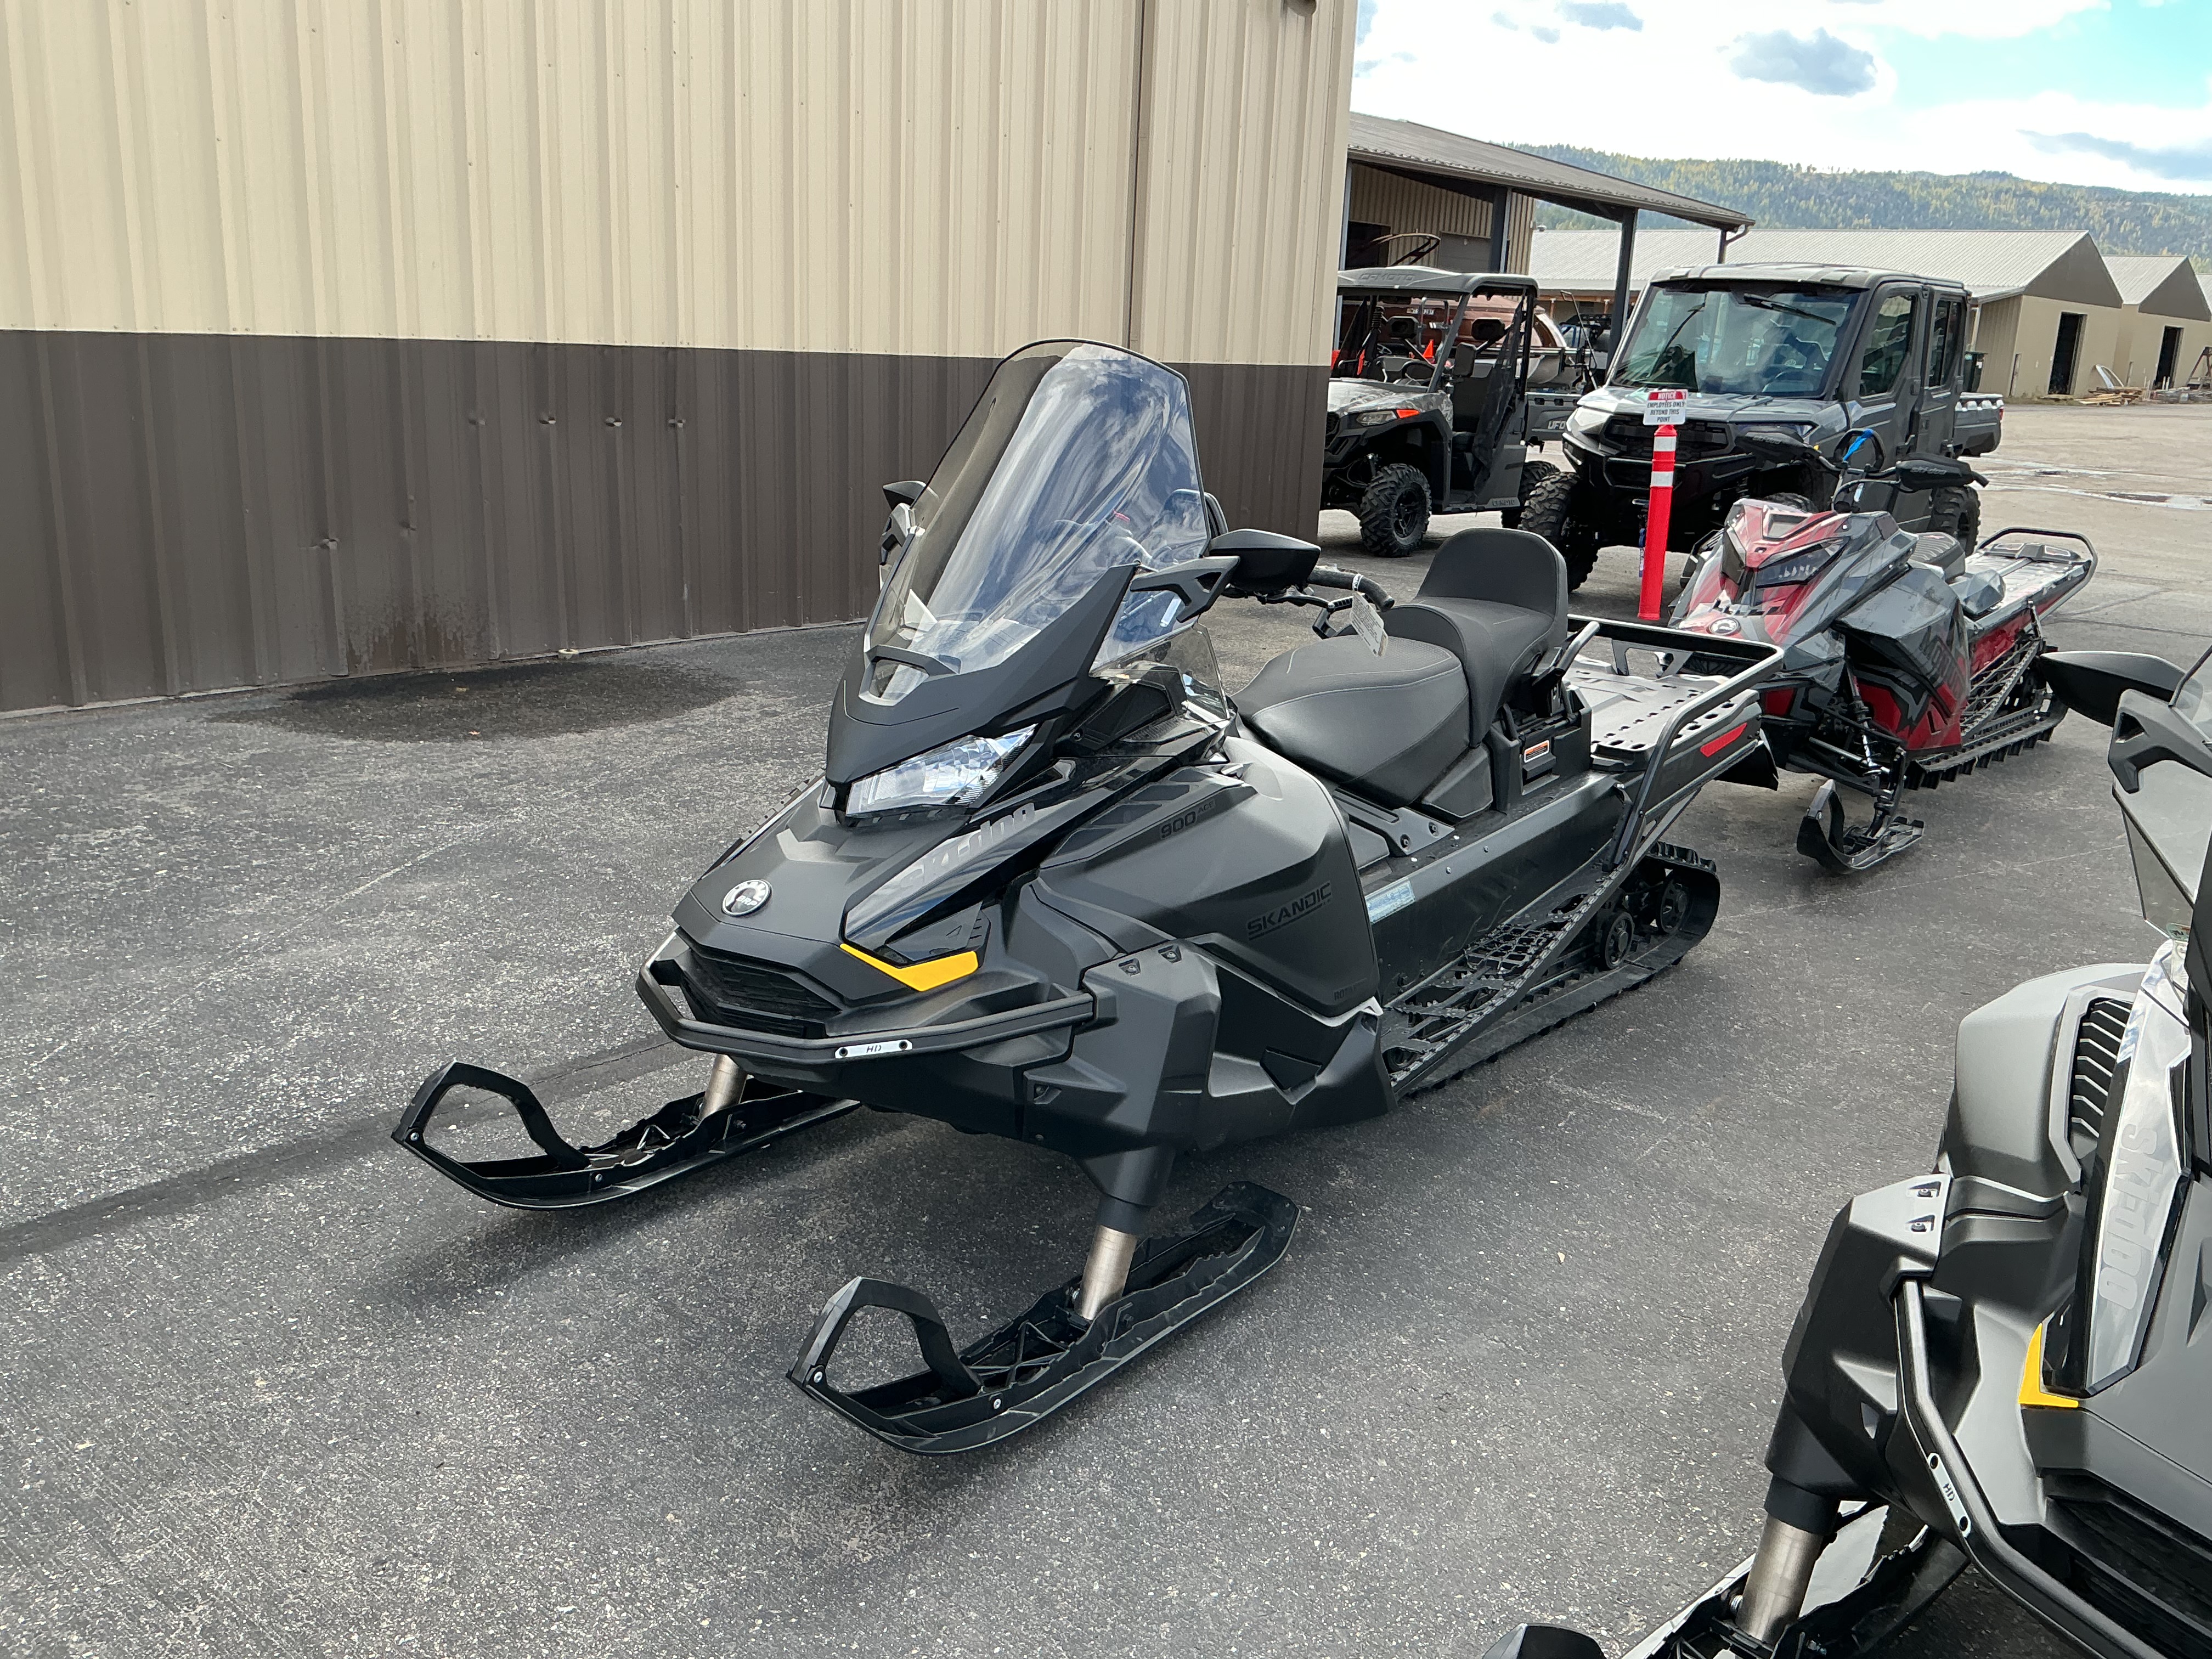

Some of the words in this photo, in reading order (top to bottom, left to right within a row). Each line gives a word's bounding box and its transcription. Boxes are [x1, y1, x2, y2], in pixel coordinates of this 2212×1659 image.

[1161, 811, 1196, 838] 900
[736, 895, 758, 906] BRP
[1247, 882, 1331, 935] SKANDIC
[866, 1045, 882, 1053] HD
[1943, 1483, 1955, 1502] HD
